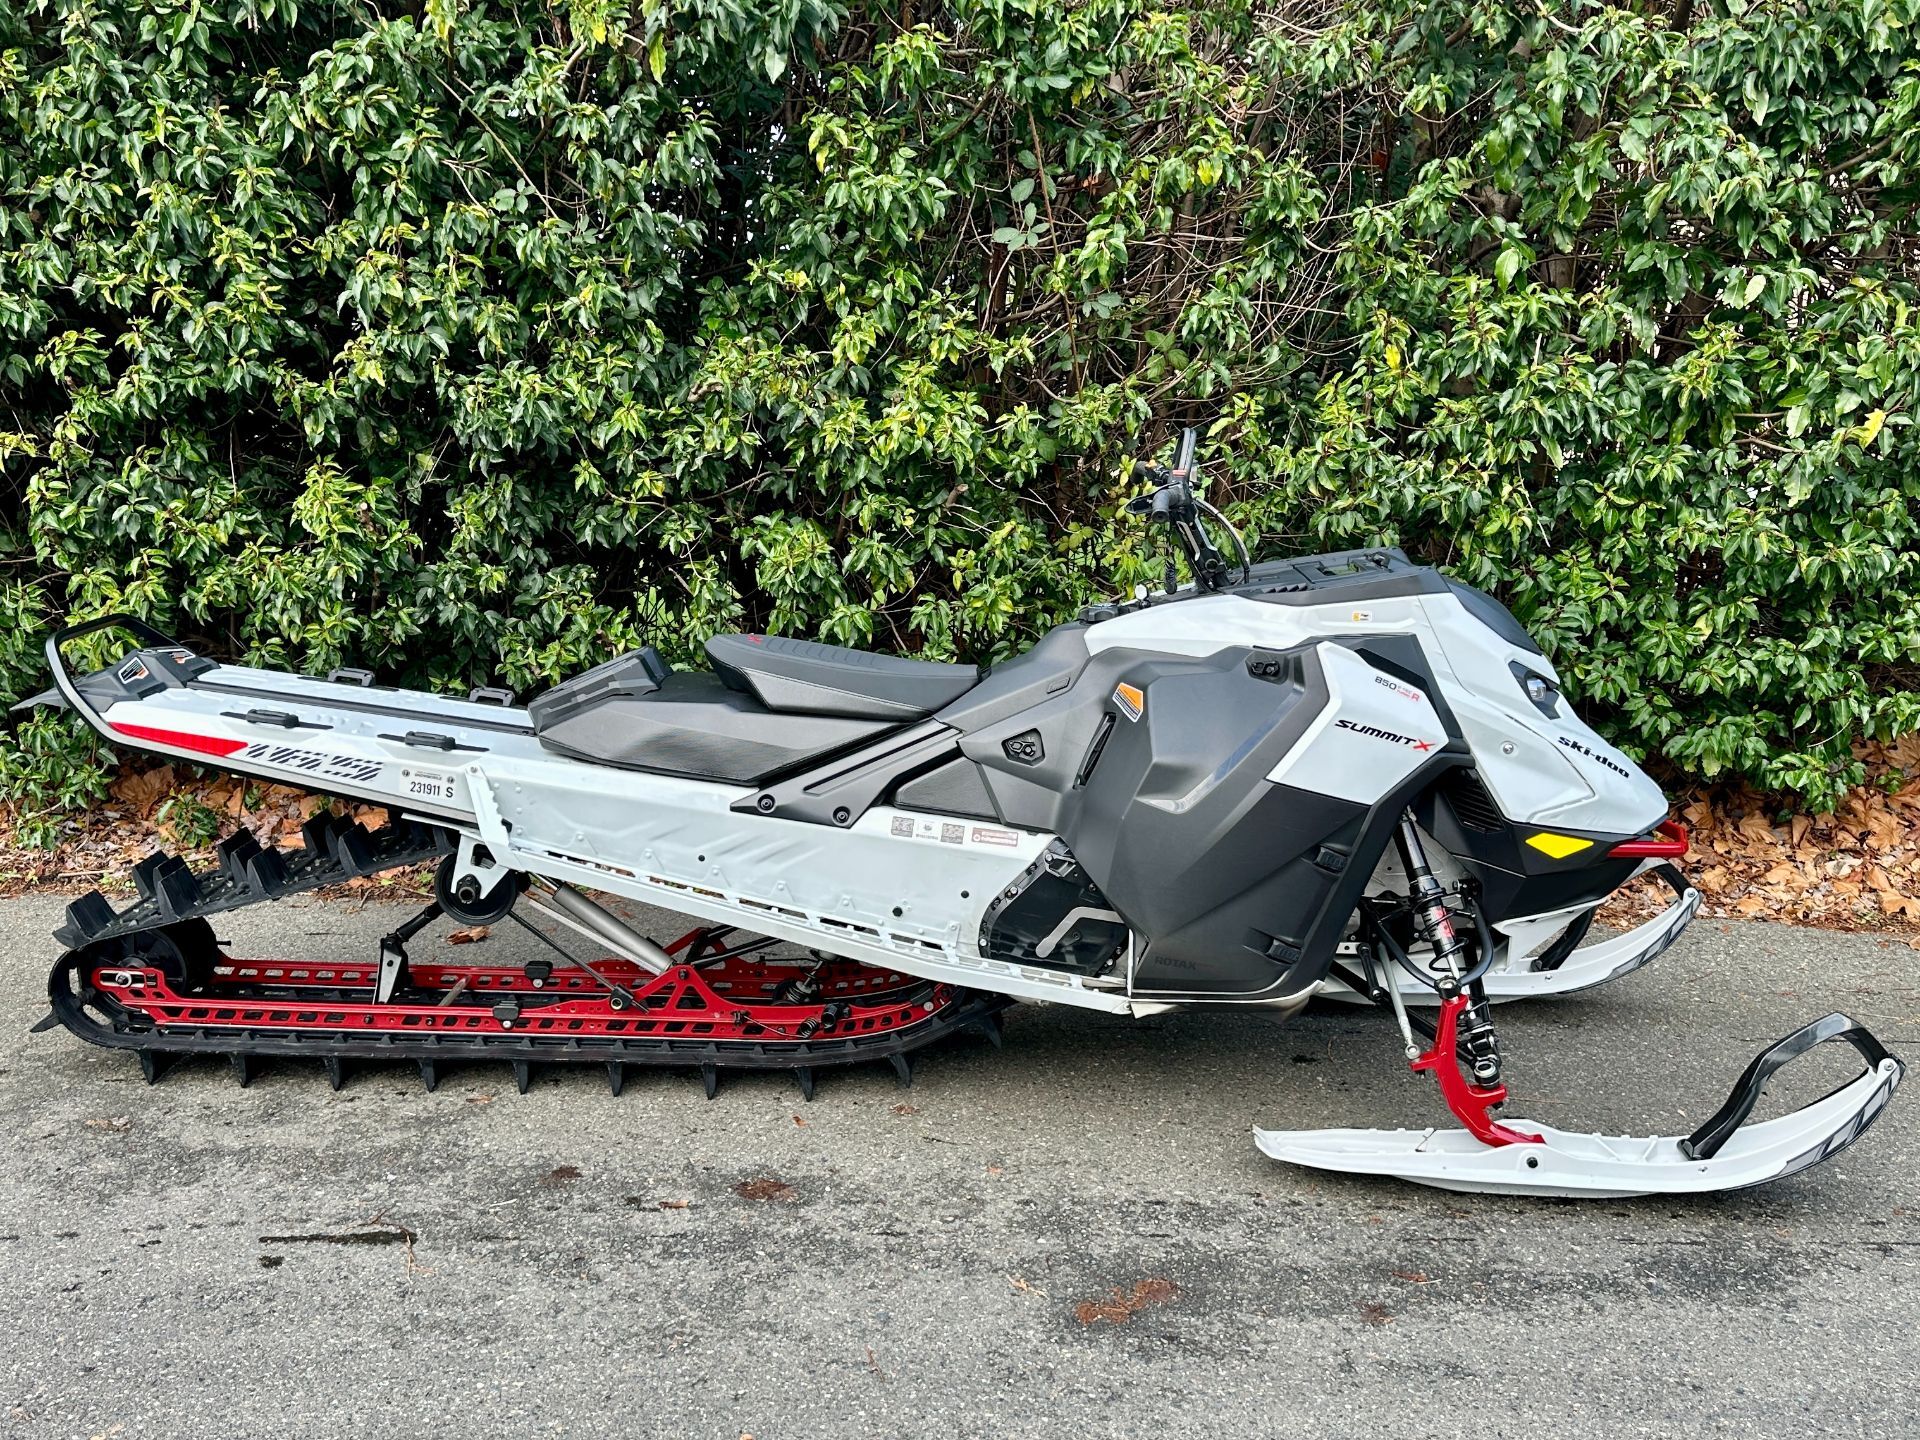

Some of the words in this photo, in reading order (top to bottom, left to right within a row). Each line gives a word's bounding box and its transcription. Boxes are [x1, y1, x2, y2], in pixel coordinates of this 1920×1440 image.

[1375, 676, 1397, 691] 850
[1411, 692, 1421, 702] R
[1335, 719, 1417, 745] SUMMIT
[410, 781, 441, 796] 231911
[445, 786, 454, 798] S
[1154, 956, 1197, 970] ROTAX
